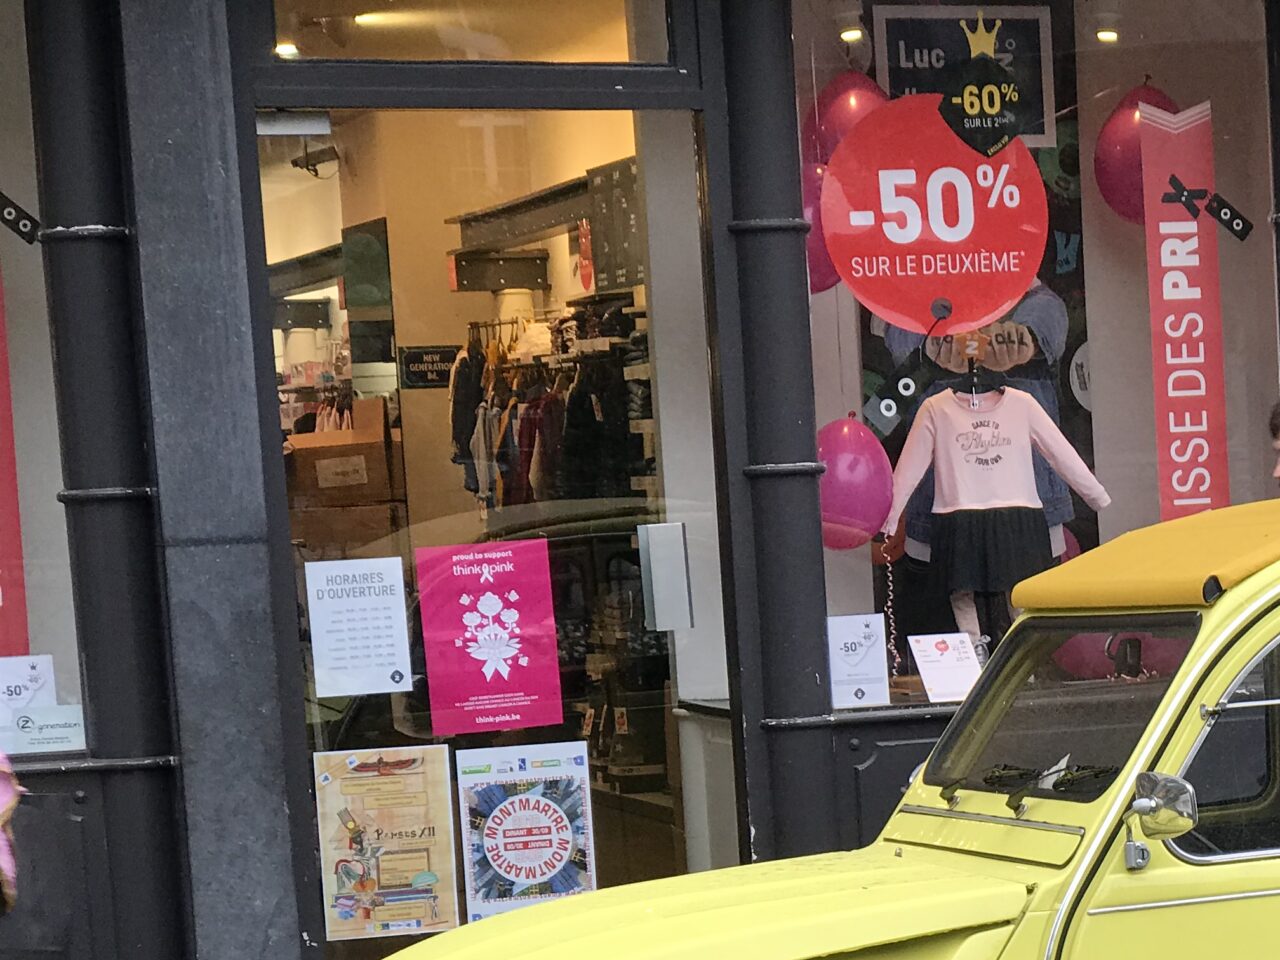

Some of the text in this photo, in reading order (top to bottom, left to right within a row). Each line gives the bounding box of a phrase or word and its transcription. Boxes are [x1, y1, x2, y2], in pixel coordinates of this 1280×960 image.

[951, 83, 1019, 116] -60%
[963, 117, 982, 128] SUR
[982, 117, 993, 128] LE
[849, 163, 1021, 245] -50%
[851, 256, 891, 278] SUR
[895, 254, 917, 277] LE
[1164, 312, 1207, 397] DES
[1170, 409, 1212, 507] ISSE
[452, 554, 474, 562] proud
[484, 550, 513, 559] support
[452, 561, 515, 576] think pink
[326, 572, 384, 587] HORAIRES
[316, 584, 396, 600] D'OUVERTURE
[840, 640, 863, 653] -50%
[2, 684, 29, 697] -50%
[485, 797, 569, 840] MONTMARTRE
